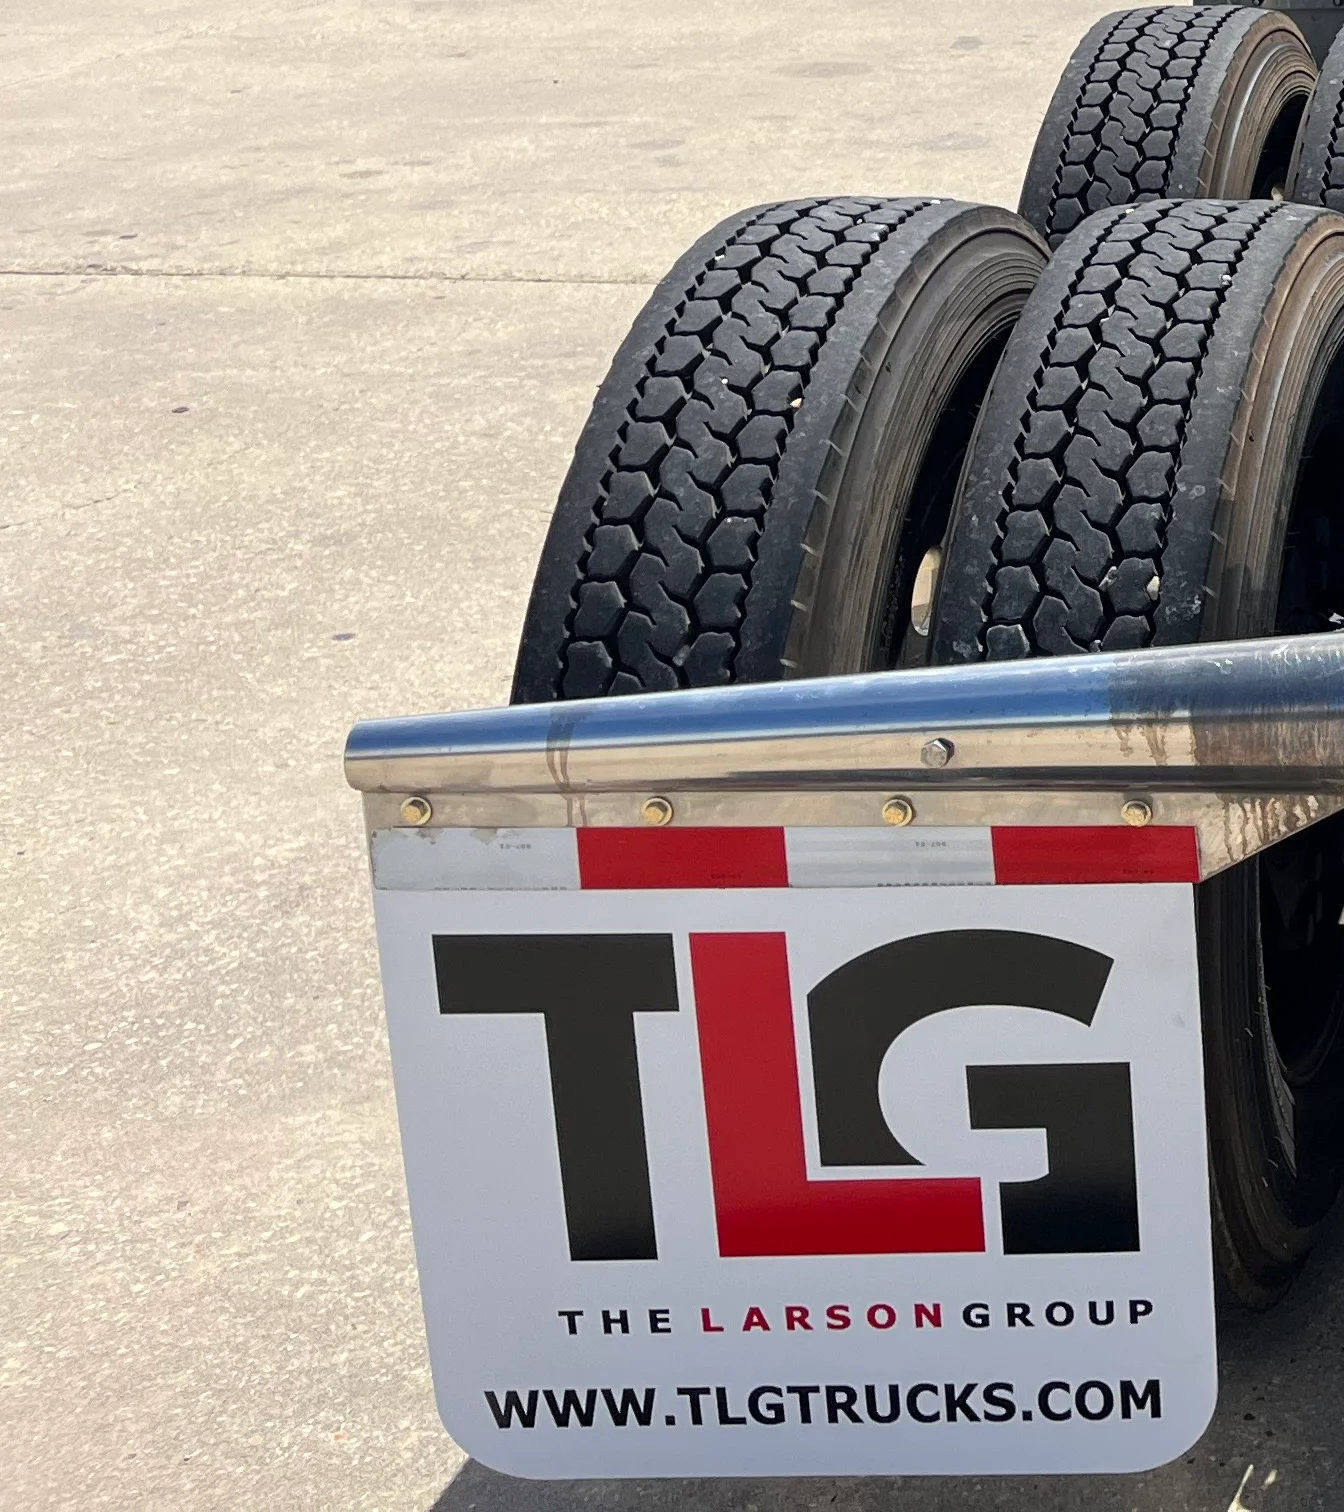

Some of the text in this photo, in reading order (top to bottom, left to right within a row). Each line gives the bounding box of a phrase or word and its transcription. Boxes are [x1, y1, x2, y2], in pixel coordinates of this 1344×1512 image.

[432, 929, 1142, 1263] TLG
[558, 1309, 673, 1336] THE
[484, 1379, 1164, 1430] WWW.TLGTRUCKS.COM
